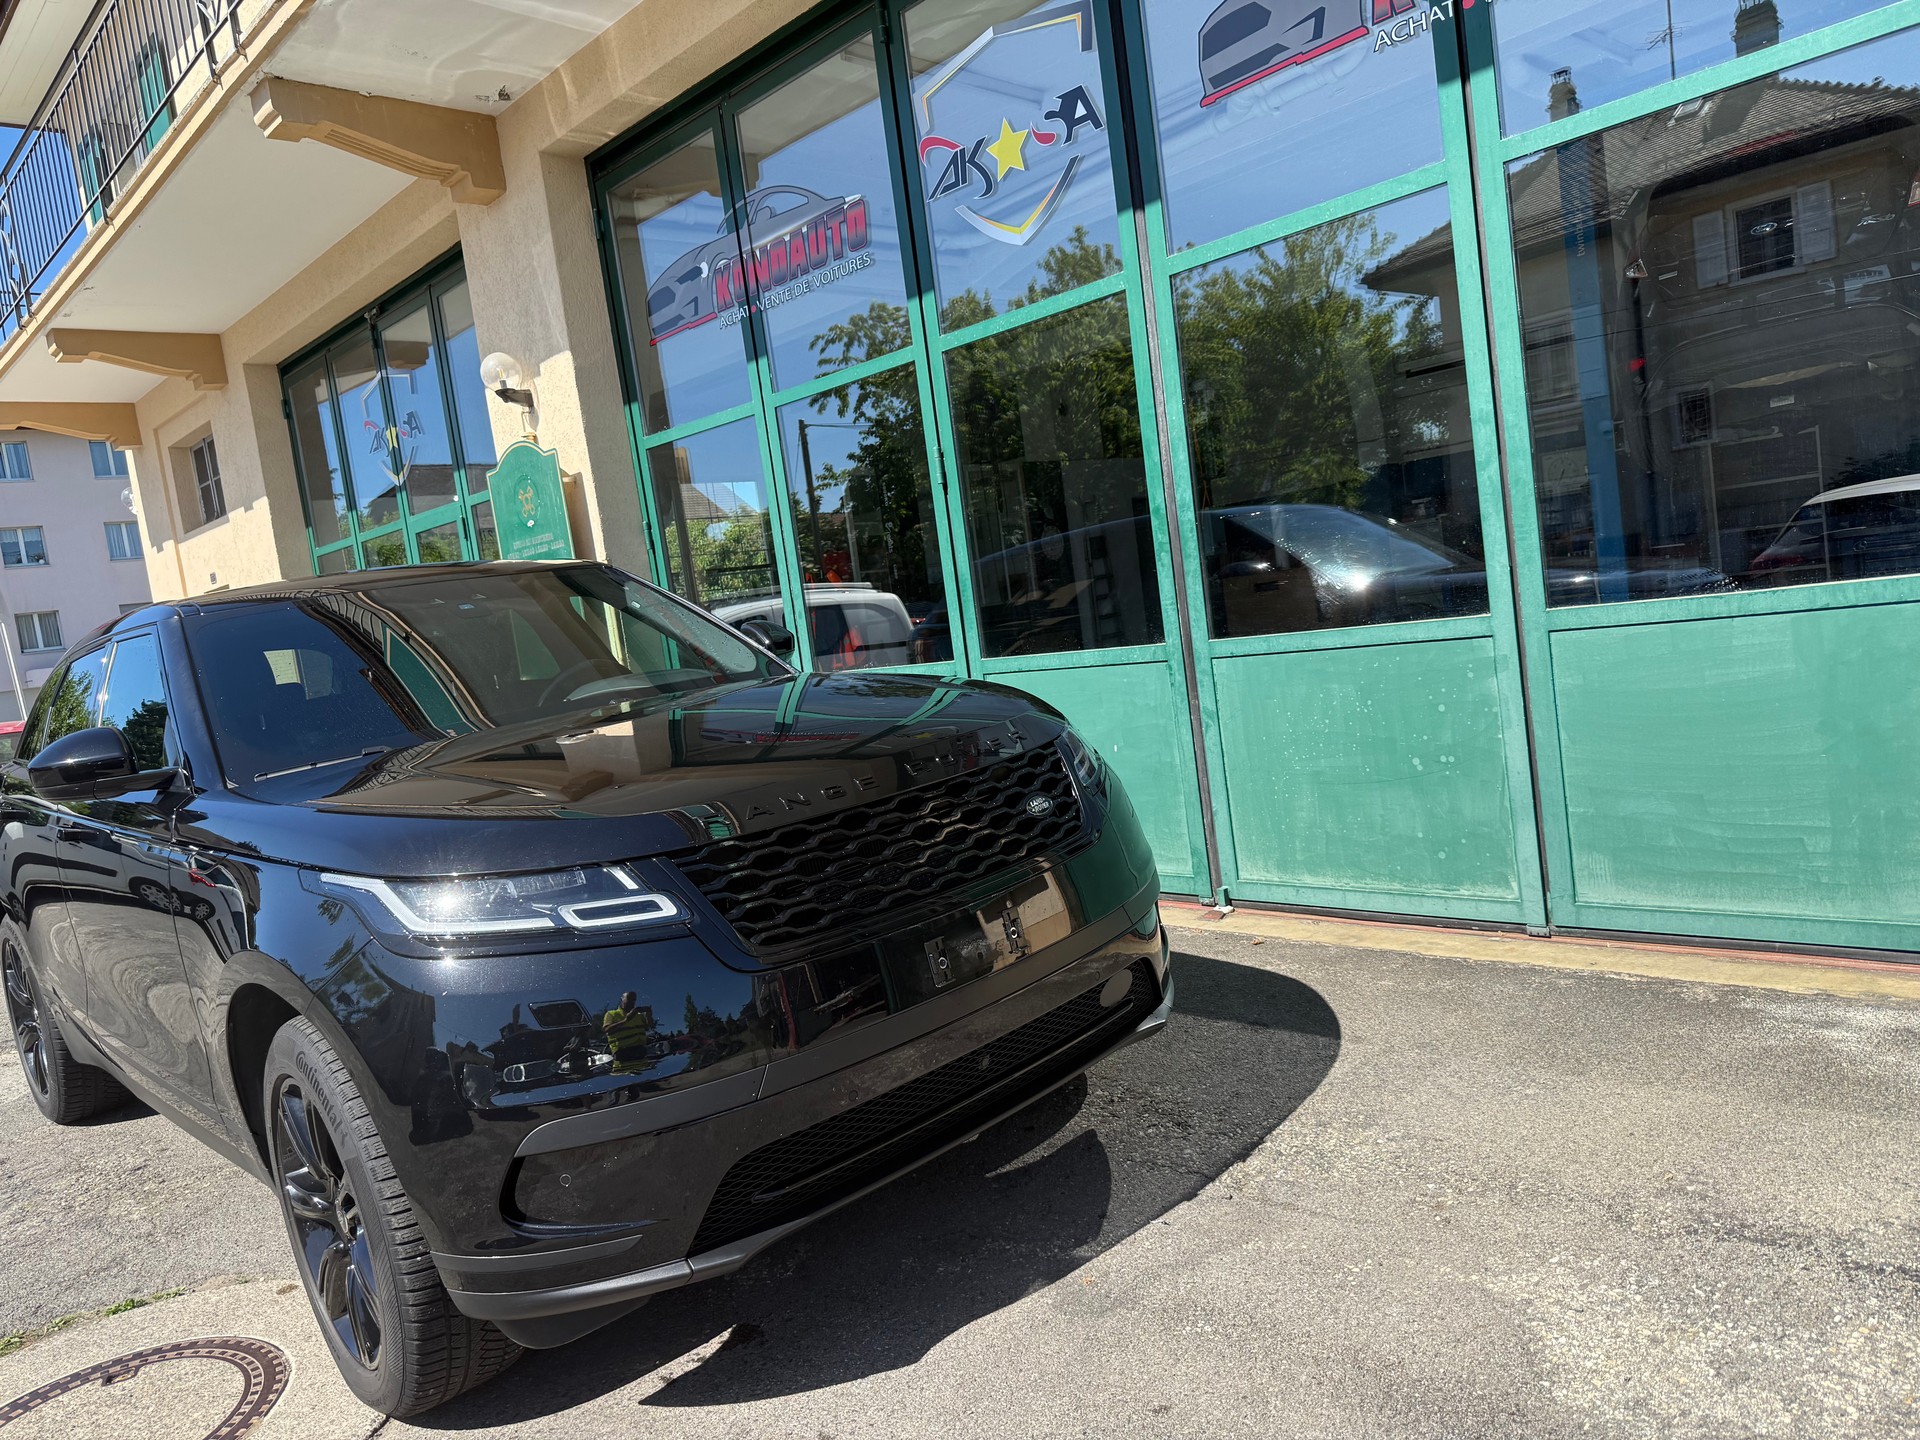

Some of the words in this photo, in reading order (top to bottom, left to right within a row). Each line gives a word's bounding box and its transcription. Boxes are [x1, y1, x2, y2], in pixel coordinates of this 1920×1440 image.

[1373, 0, 1454, 53] ACHAT
[794, 279, 810, 298] DE
[812, 252, 872, 288] VOITURES
[295, 1050, 343, 1134] Continental
